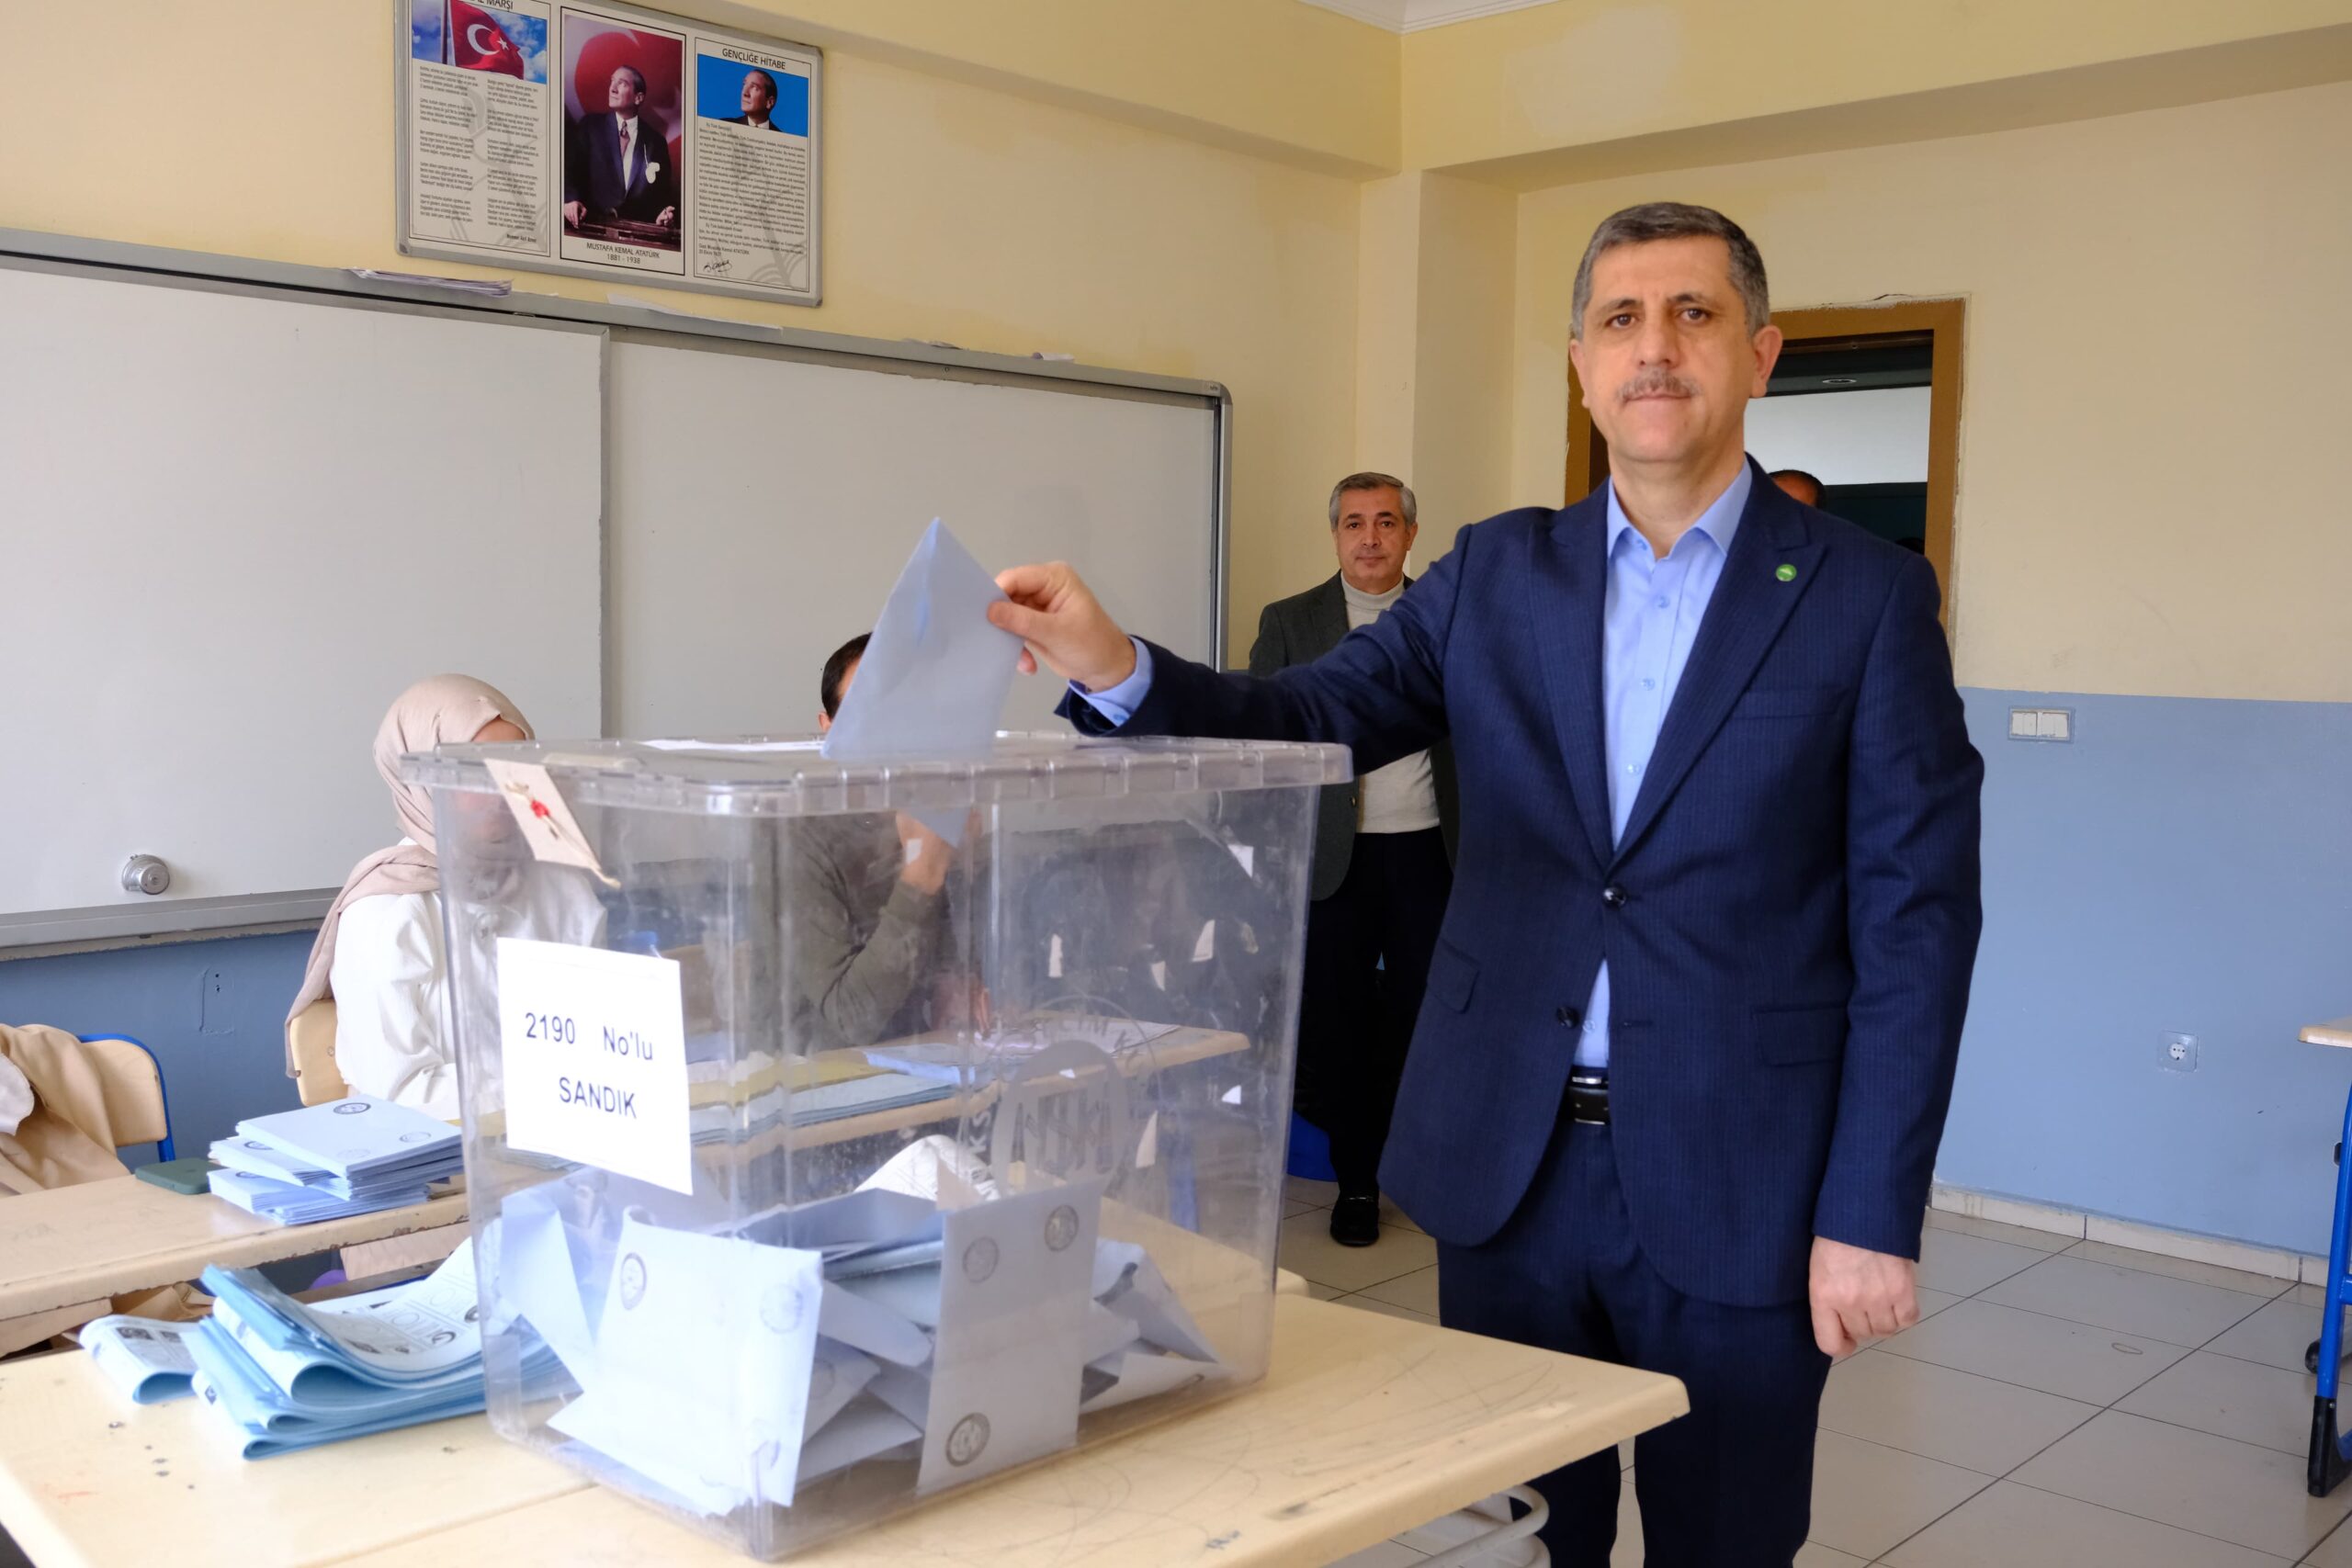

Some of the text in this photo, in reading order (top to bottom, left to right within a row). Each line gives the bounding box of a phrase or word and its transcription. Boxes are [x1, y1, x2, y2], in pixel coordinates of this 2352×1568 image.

[722, 48, 786, 69] GENÇLİĞE HİTABE
[586, 242, 661, 258] MUSTAFA KEMAL ATATÜRK
[607, 254, 621, 262] 1881
[526, 1012, 653, 1060] 2190 No'lu
[559, 1077, 637, 1119] SANDIK
